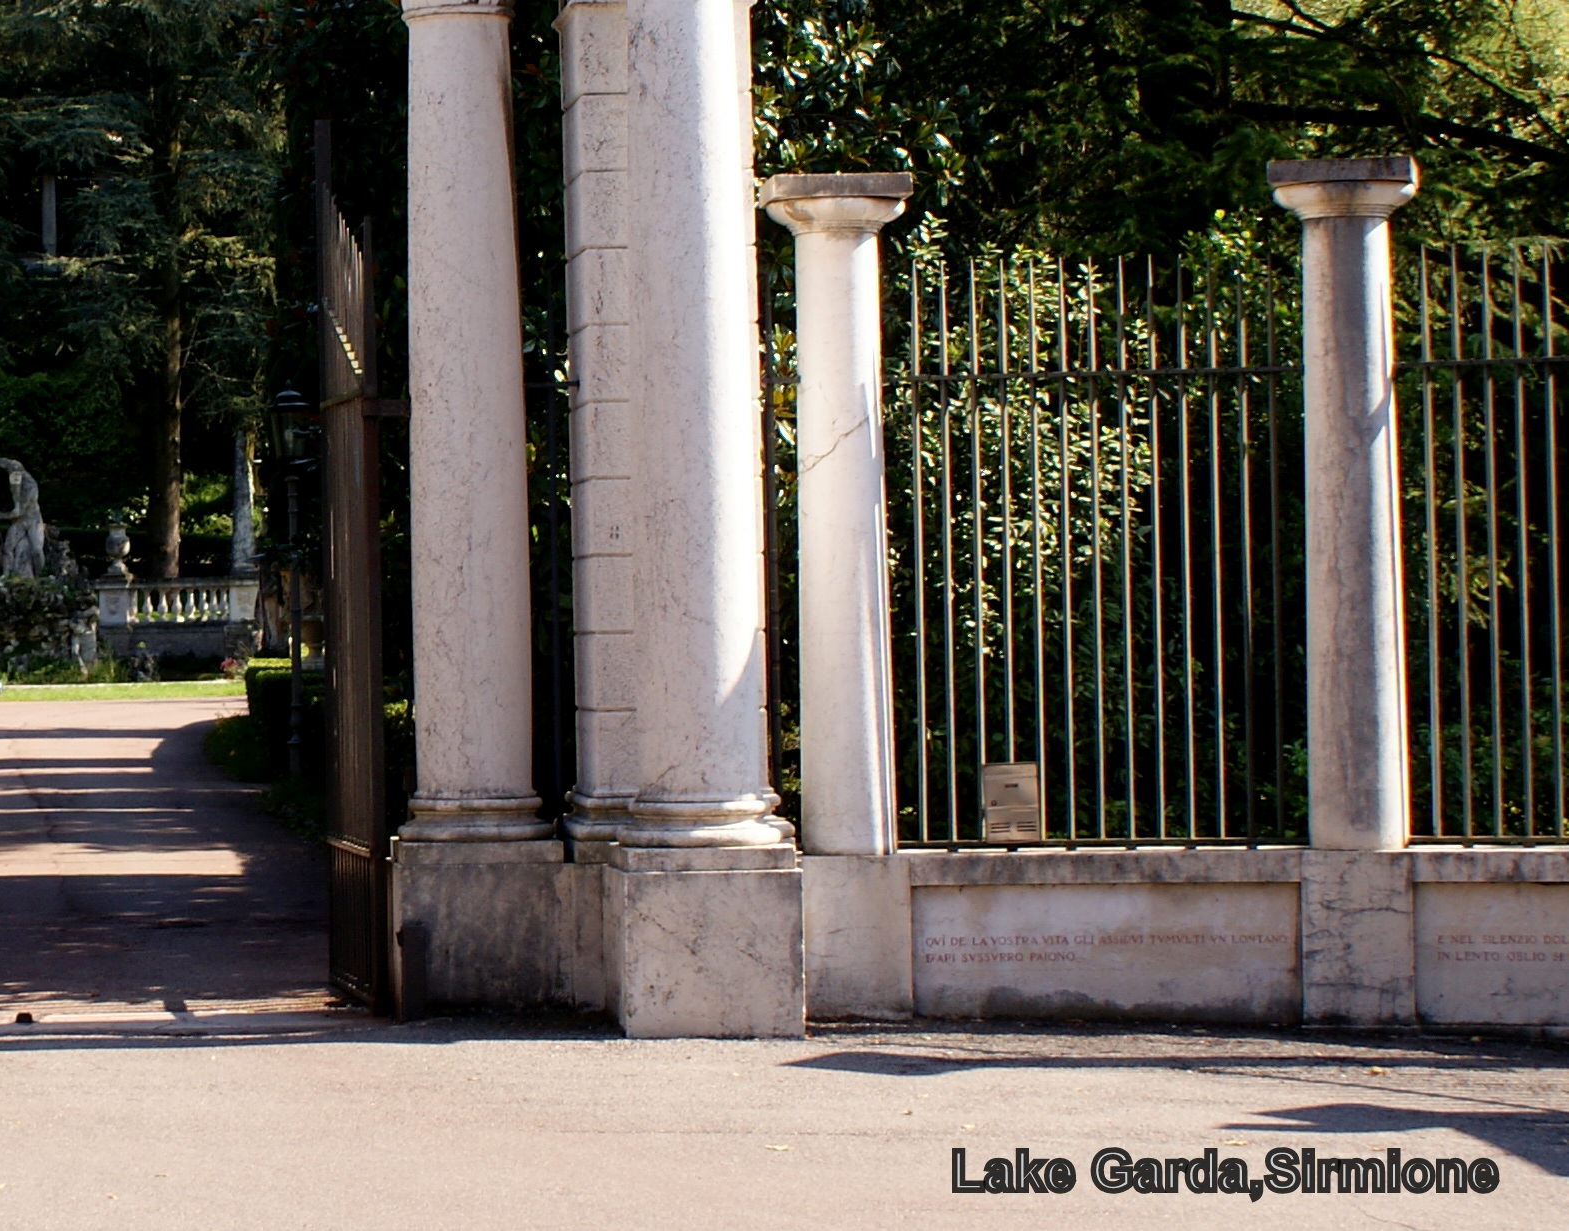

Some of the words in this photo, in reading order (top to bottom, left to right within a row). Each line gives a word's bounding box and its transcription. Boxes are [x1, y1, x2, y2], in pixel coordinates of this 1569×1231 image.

[950, 936, 967, 946] DE
[972, 936, 988, 946] LA
[990, 935, 1038, 946] VOSTRA
[1041, 935, 1070, 945] VITA
[1074, 935, 1094, 945] GLI
[1098, 935, 1143, 945] ASSIDVI
[1150, 934, 1205, 945] TVMVLTI
[1210, 934, 1227, 944] VN
[1232, 934, 1288, 944] LONTANO
[1437, 935, 1445, 944] E
[1450, 935, 1475, 944] NEL
[1481, 935, 1537, 944] SILENZIO
[960, 952, 1024, 963] SVSSVRRO
[1029, 951, 1076, 962] PAIONO
[1437, 951, 1449, 961] IN
[1455, 951, 1500, 961] LENTO
[1506, 951, 1546, 962] OBLIO
